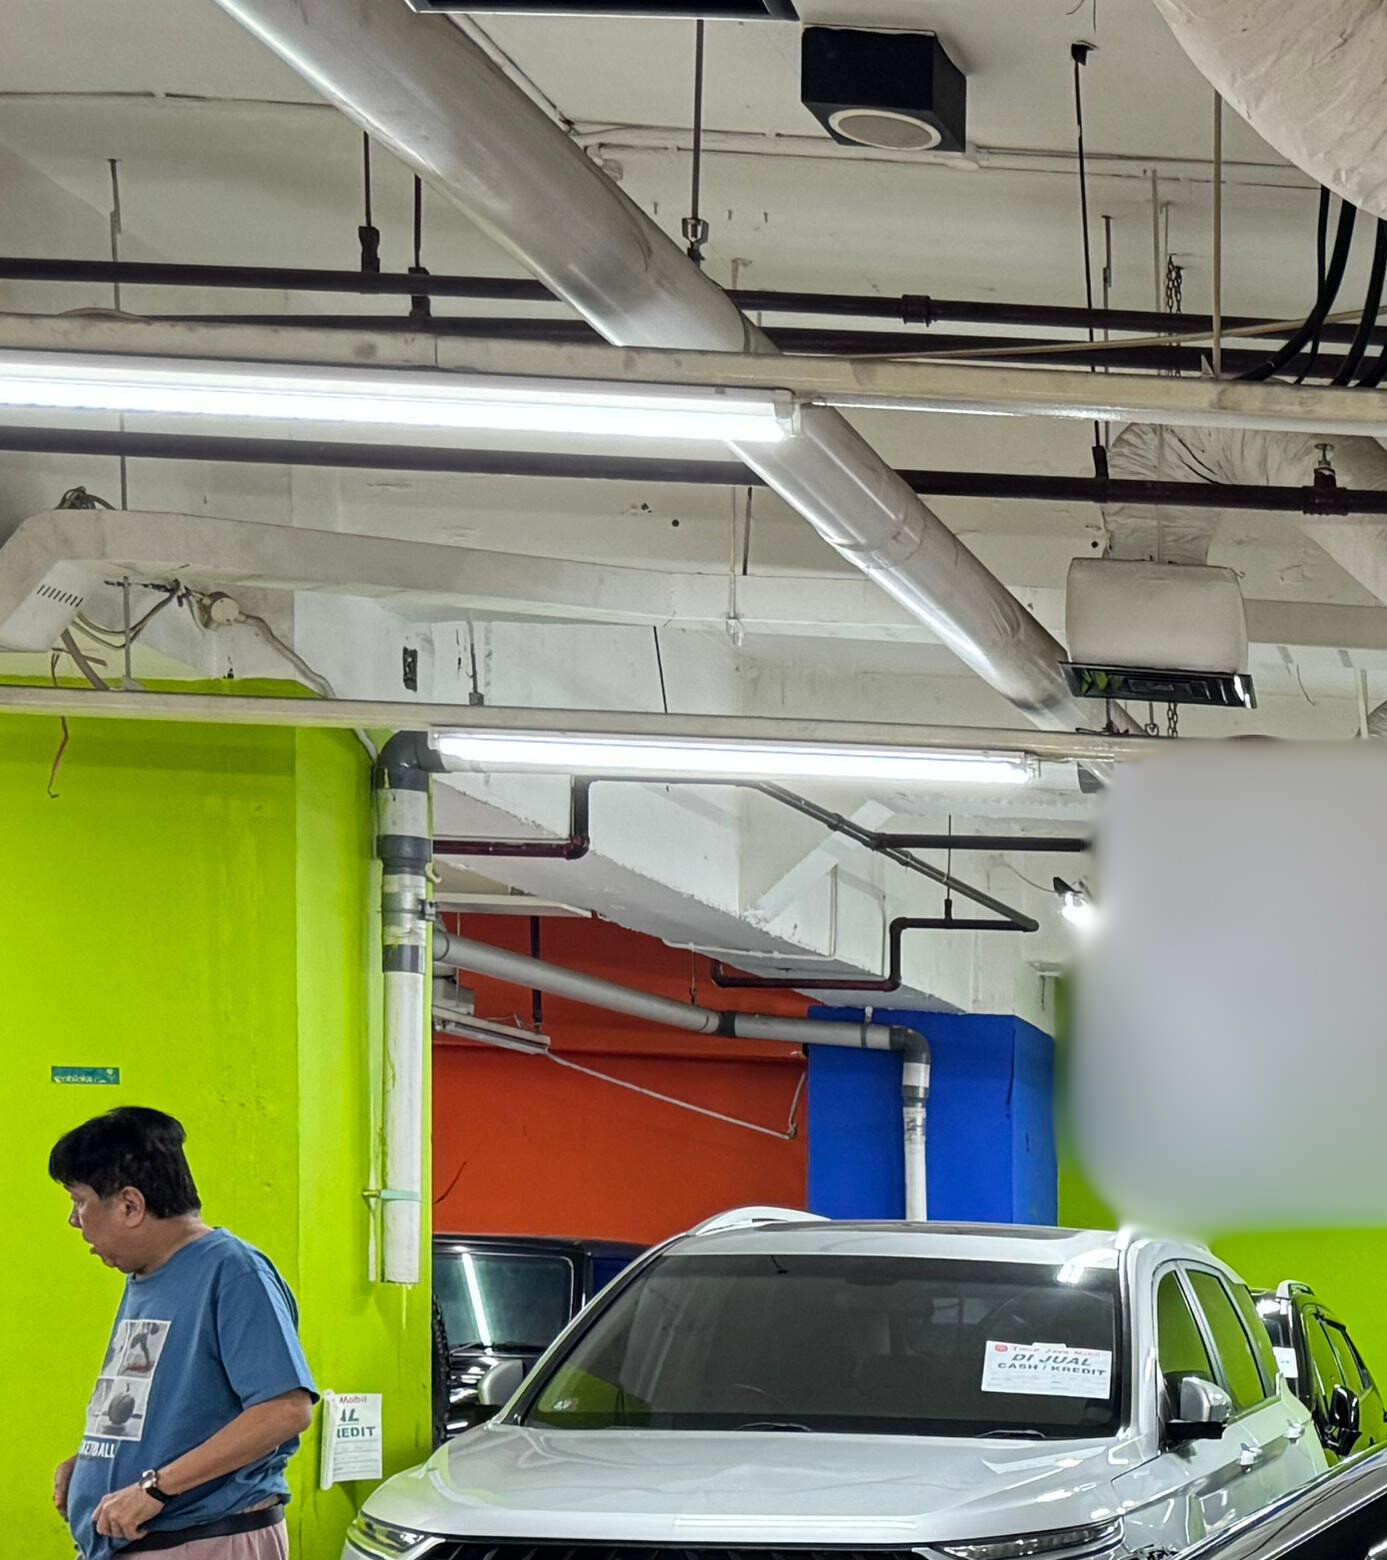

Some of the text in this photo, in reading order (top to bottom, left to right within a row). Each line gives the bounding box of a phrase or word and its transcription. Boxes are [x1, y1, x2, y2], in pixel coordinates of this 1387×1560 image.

[1011, 1353, 1092, 1367] DI JUAL
[997, 1362, 1038, 1371] CASH
[1051, 1365, 1107, 1376] KREDIT
